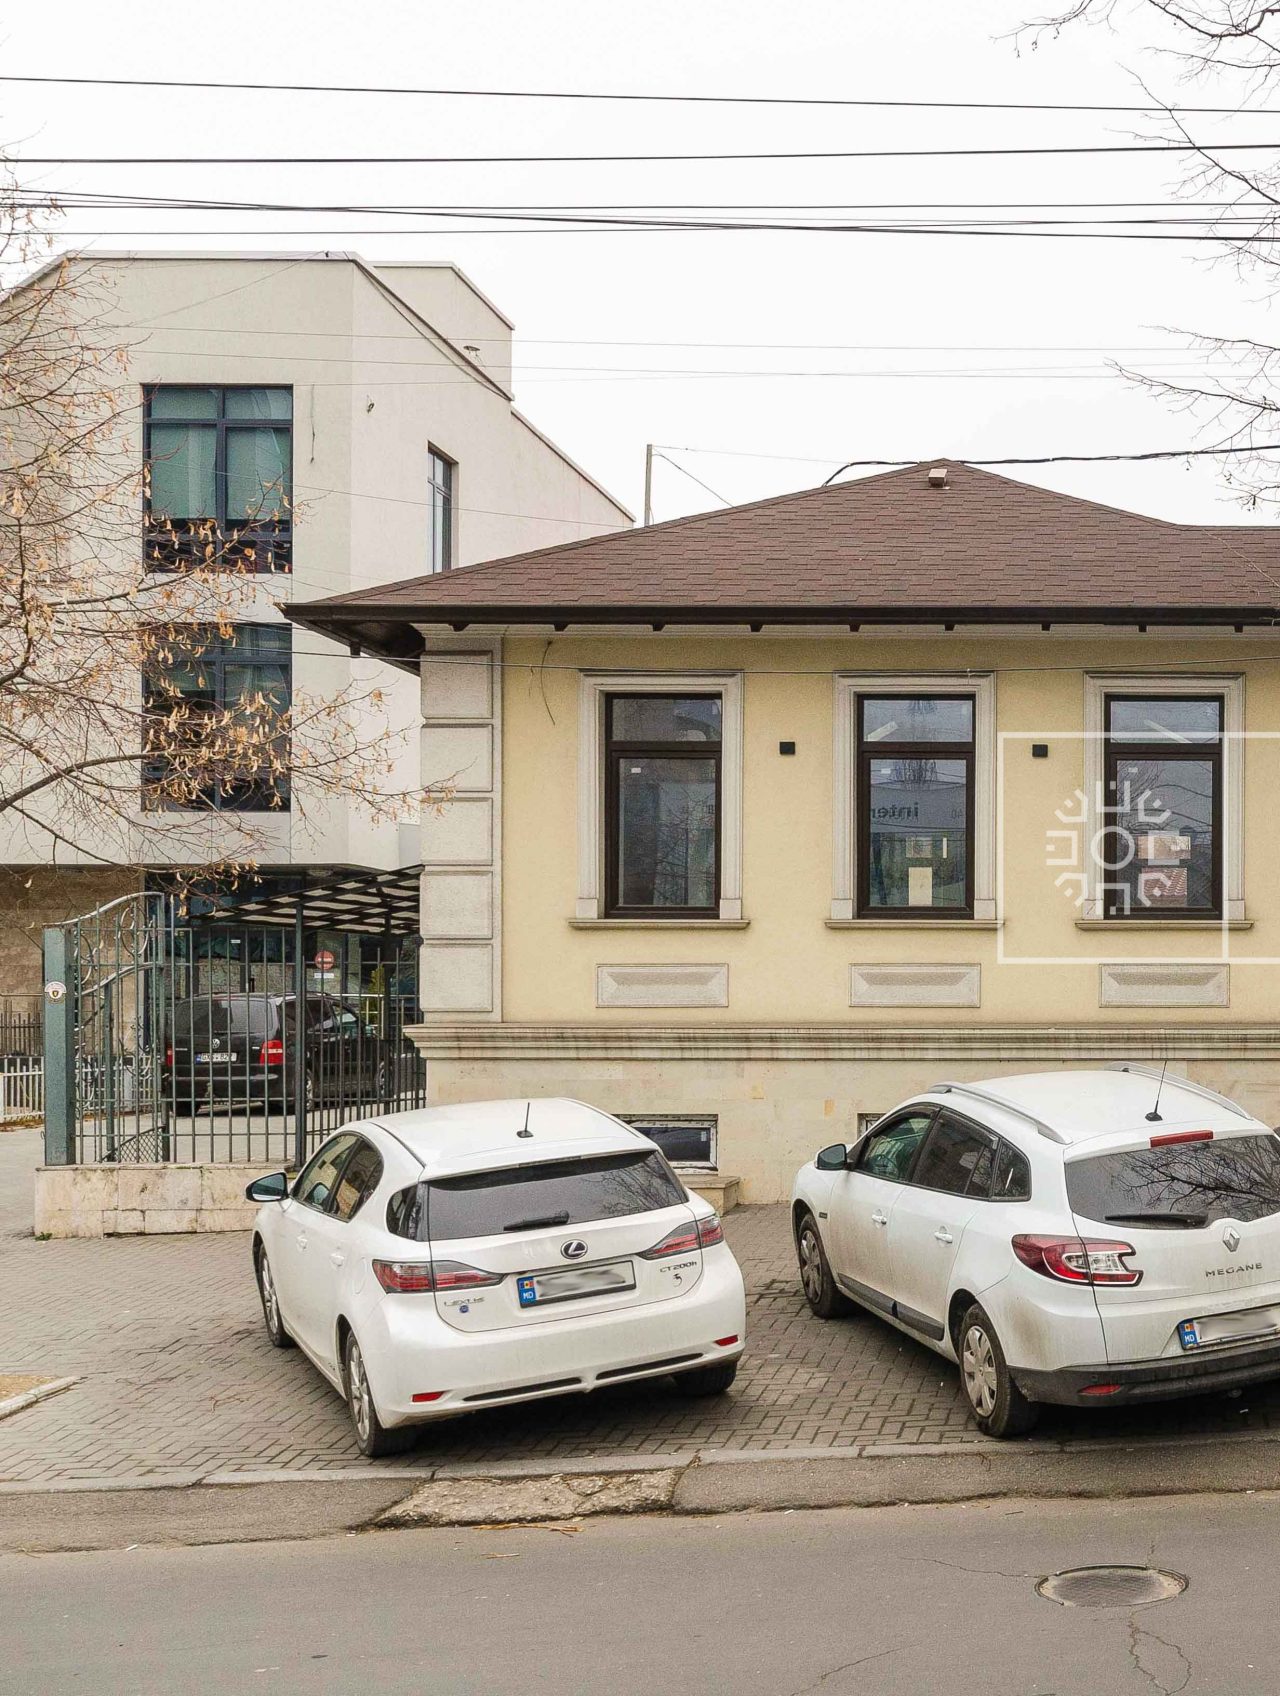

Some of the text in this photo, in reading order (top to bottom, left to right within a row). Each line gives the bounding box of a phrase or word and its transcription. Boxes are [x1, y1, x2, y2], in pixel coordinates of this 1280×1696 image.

[1205, 1262, 1263, 1277] MEGANE
[523, 1291, 534, 1299] MD
[1184, 1334, 1195, 1343] MD
